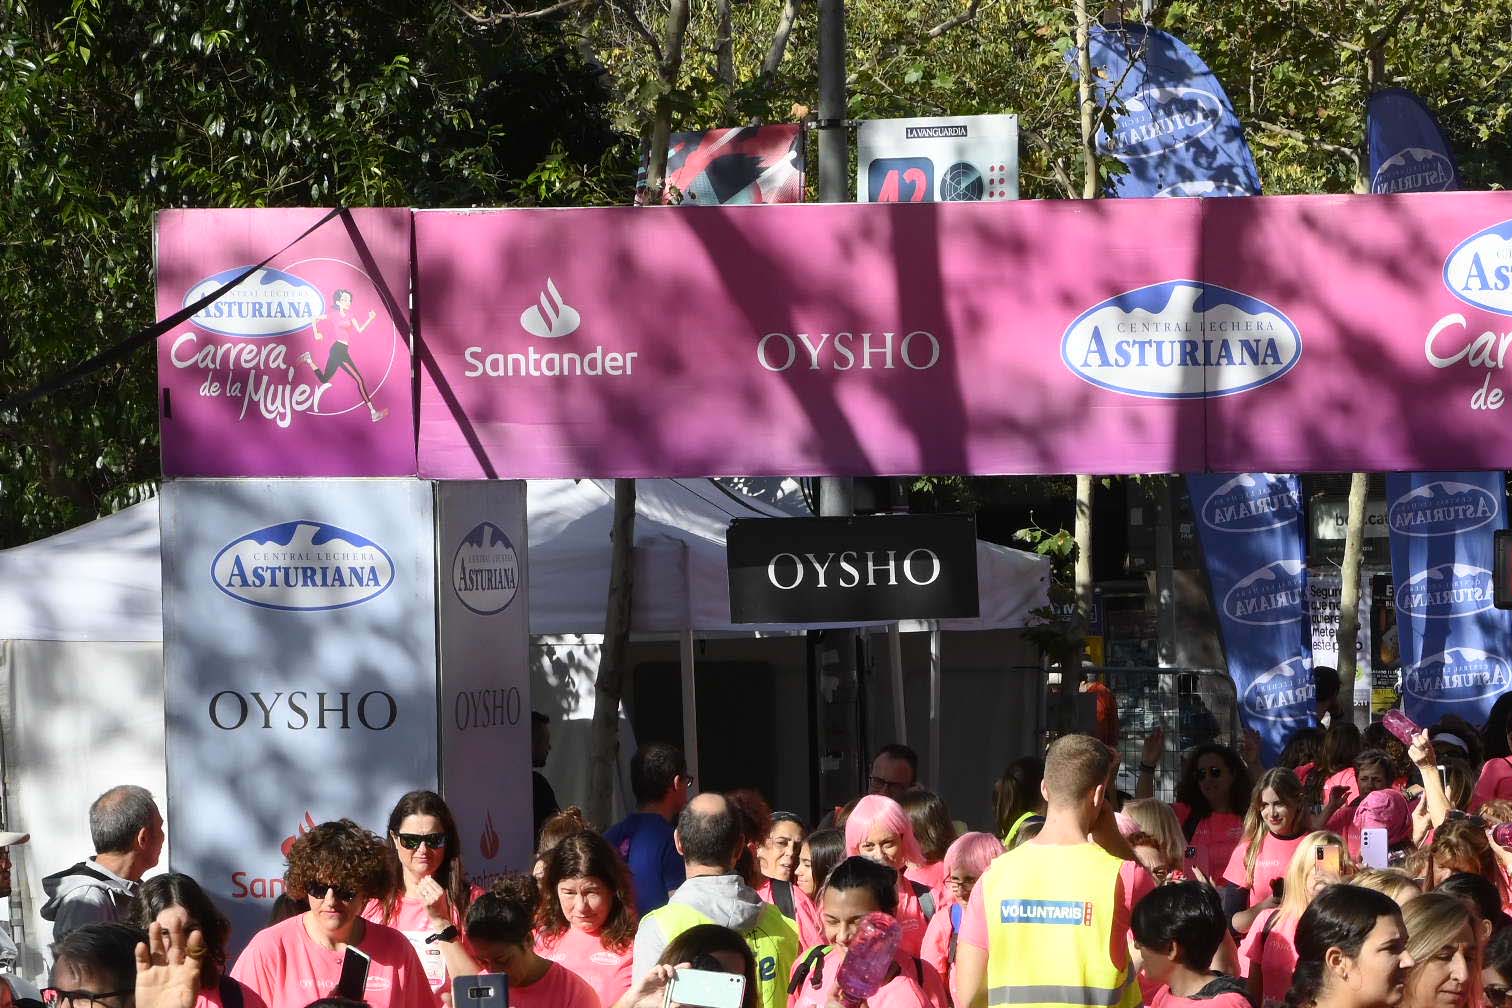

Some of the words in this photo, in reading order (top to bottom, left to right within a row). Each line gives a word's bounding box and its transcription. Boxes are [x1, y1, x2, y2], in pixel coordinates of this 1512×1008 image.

[1117, 321, 1191, 333] CENTRAL
[1200, 320, 1275, 332] LECHERA
[170, 332, 288, 369] Carrera
[465, 346, 637, 378] Santander
[757, 331, 941, 372] OYSHO
[1079, 325, 1283, 368] ASTURIANA
[200, 372, 221, 397] de
[226, 371, 242, 397] la
[240, 366, 333, 428] Mujer
[1470, 371, 1505, 411] de
[225, 554, 382, 588] ASTURIANA
[253, 552, 313, 562] CENTRAL
[317, 552, 375, 562] LECHERA
[458, 556, 516, 592] ASTURIANA
[767, 548, 941, 591] OYSHO
[208, 690, 398, 731] OYSHO
[455, 686, 521, 731] OYSHO
[1001, 904, 1082, 920] VOLUNTARIS
